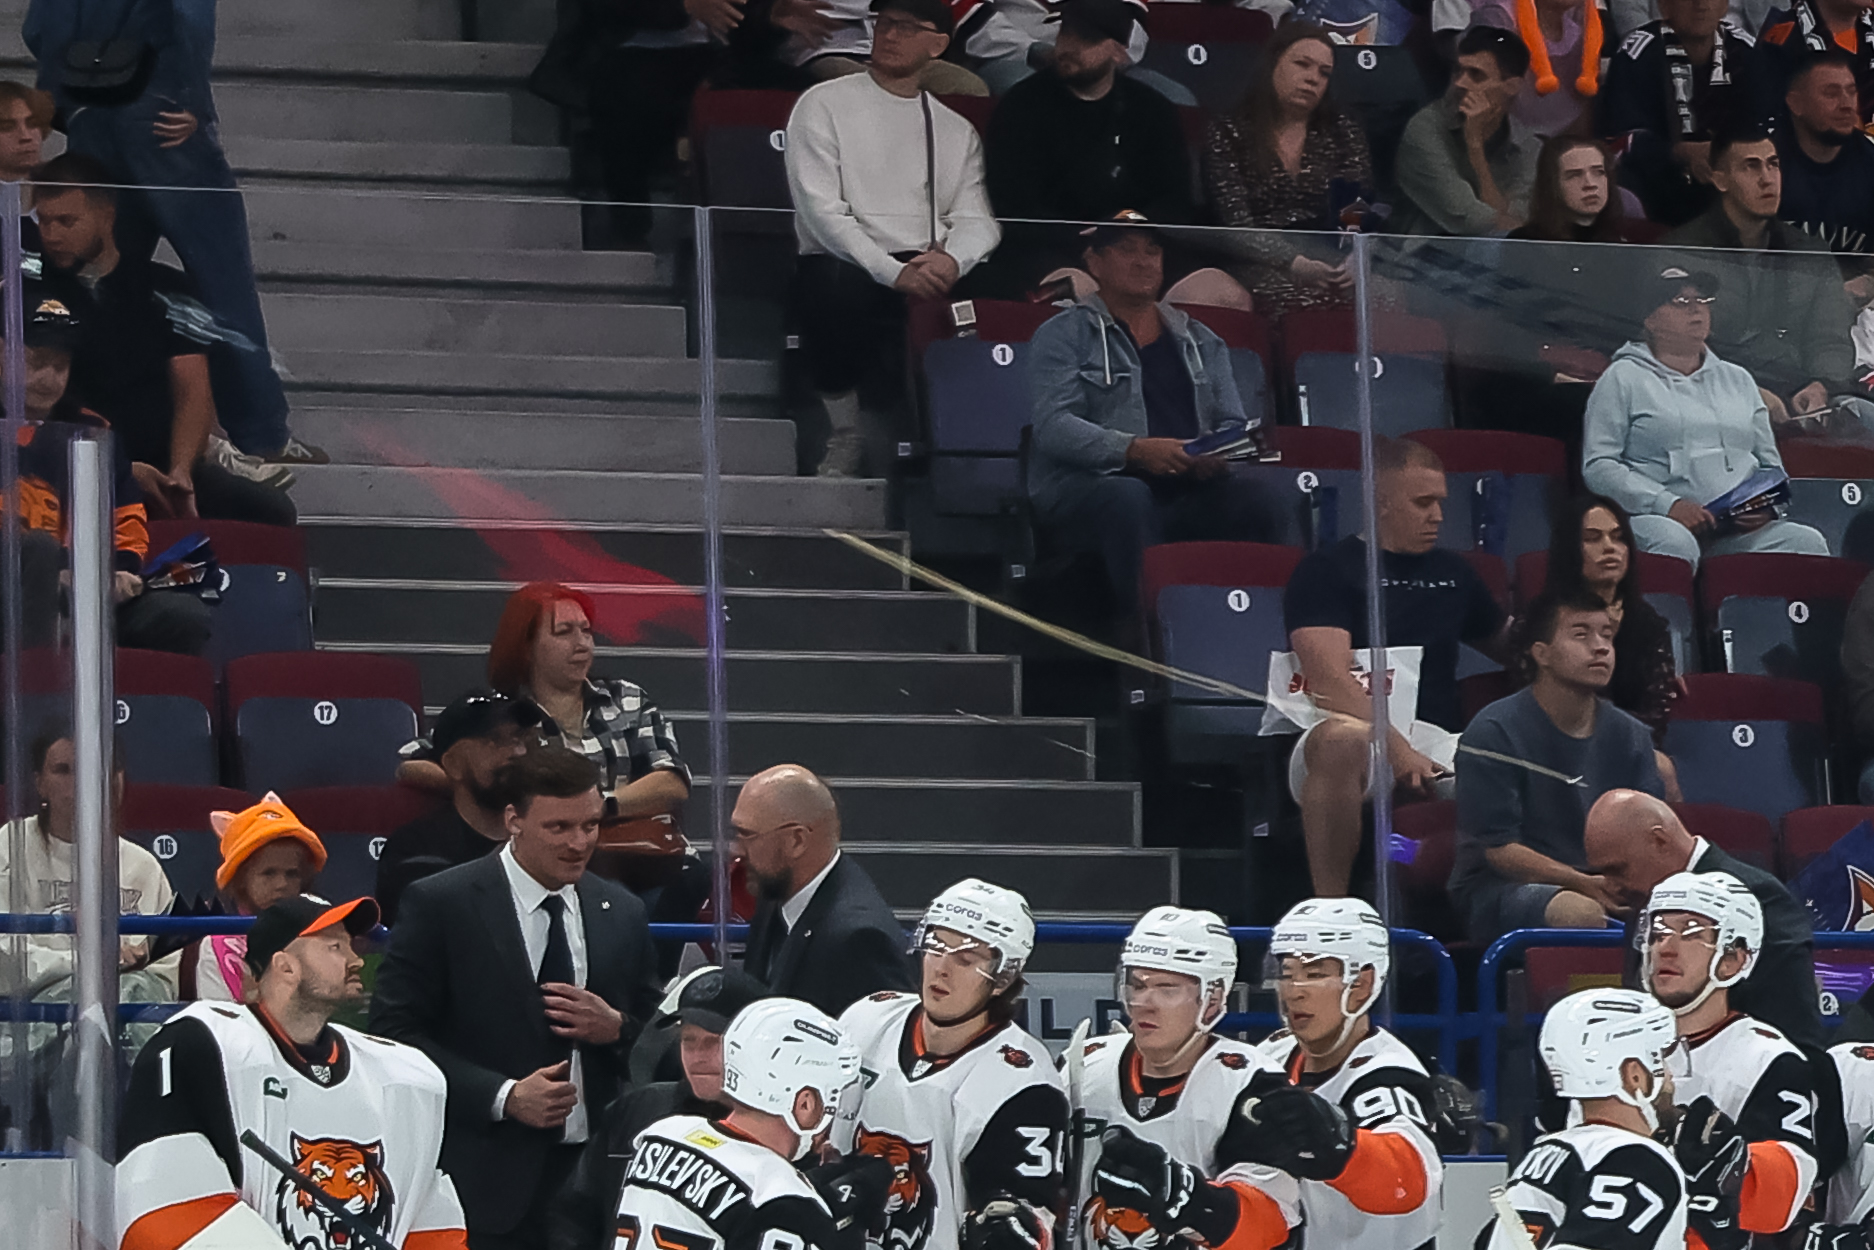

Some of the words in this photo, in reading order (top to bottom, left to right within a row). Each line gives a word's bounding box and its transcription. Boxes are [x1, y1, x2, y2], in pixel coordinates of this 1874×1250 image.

[315, 703, 337, 722] 17
[156, 838, 174, 858] 16
[158, 1046, 175, 1097] 1
[1778, 1090, 1820, 1144] 2
[1582, 1174, 1666, 1234] 57
